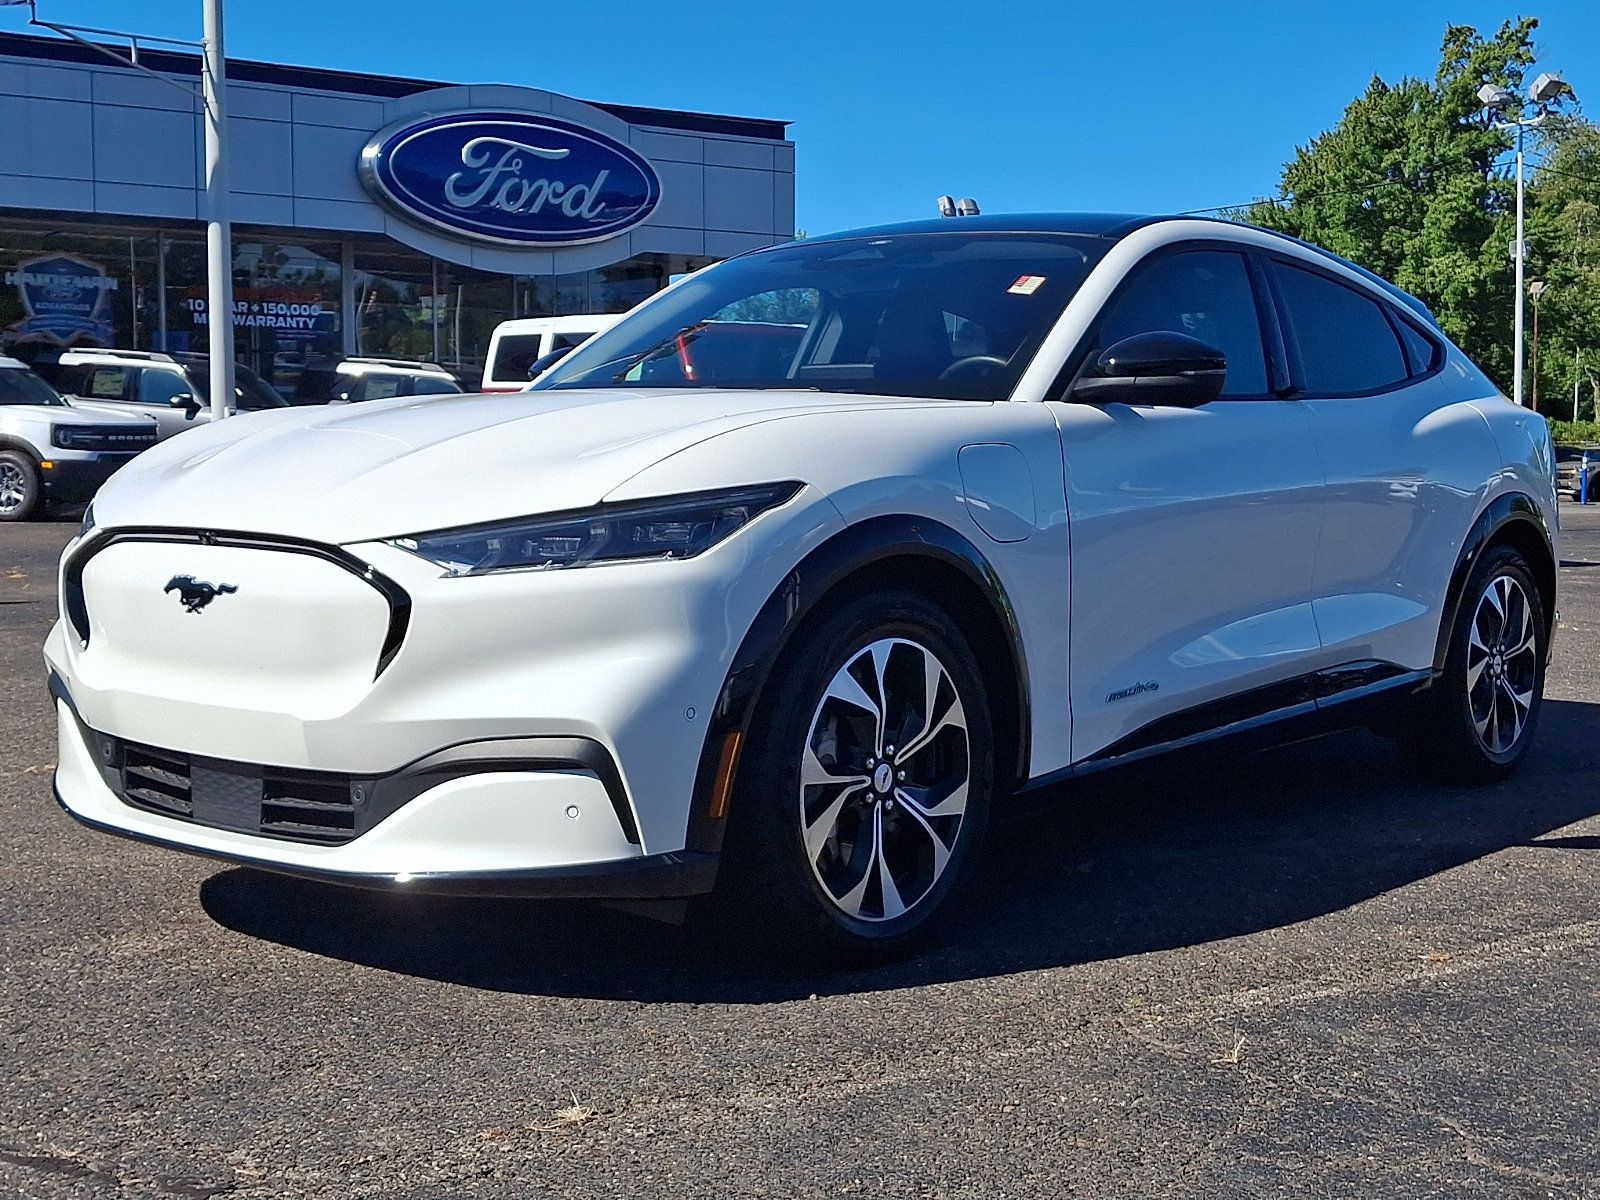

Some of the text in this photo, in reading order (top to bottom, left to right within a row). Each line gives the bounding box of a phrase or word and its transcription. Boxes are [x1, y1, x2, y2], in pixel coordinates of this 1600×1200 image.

[445, 137, 610, 219] Ford
[188, 299, 205, 311] 10
[262, 302, 320, 316] 150,000
[232, 314, 317, 329] WARRANTY
